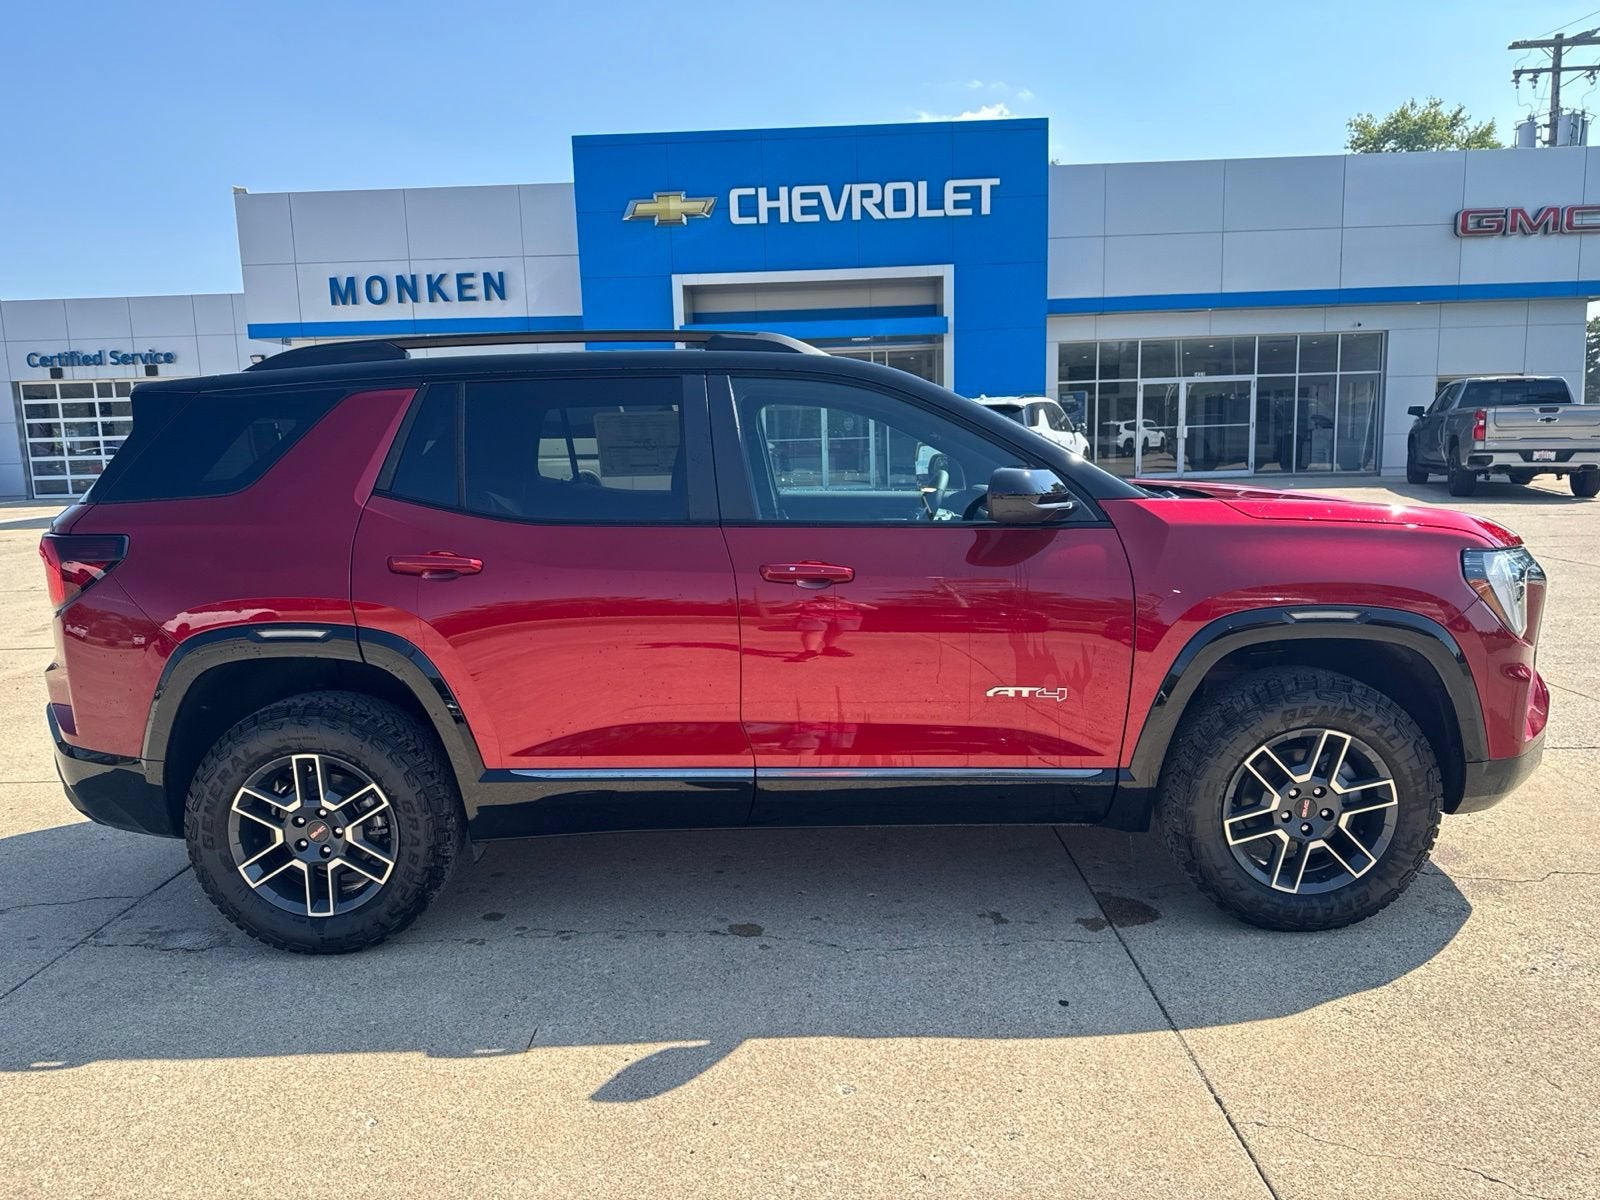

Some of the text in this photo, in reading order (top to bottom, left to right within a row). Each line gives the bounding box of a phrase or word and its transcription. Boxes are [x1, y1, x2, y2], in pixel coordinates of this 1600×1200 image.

[729, 177, 1000, 224] CHEVROLET
[1456, 205, 1600, 237] GMC
[328, 271, 506, 306] MONKEN
[26, 349, 175, 368] Certified Service
[986, 686, 1067, 701] AT4
[202, 746, 261, 849] GENERAL
[310, 825, 326, 838] GMC
[384, 801, 421, 913] GRABBE
